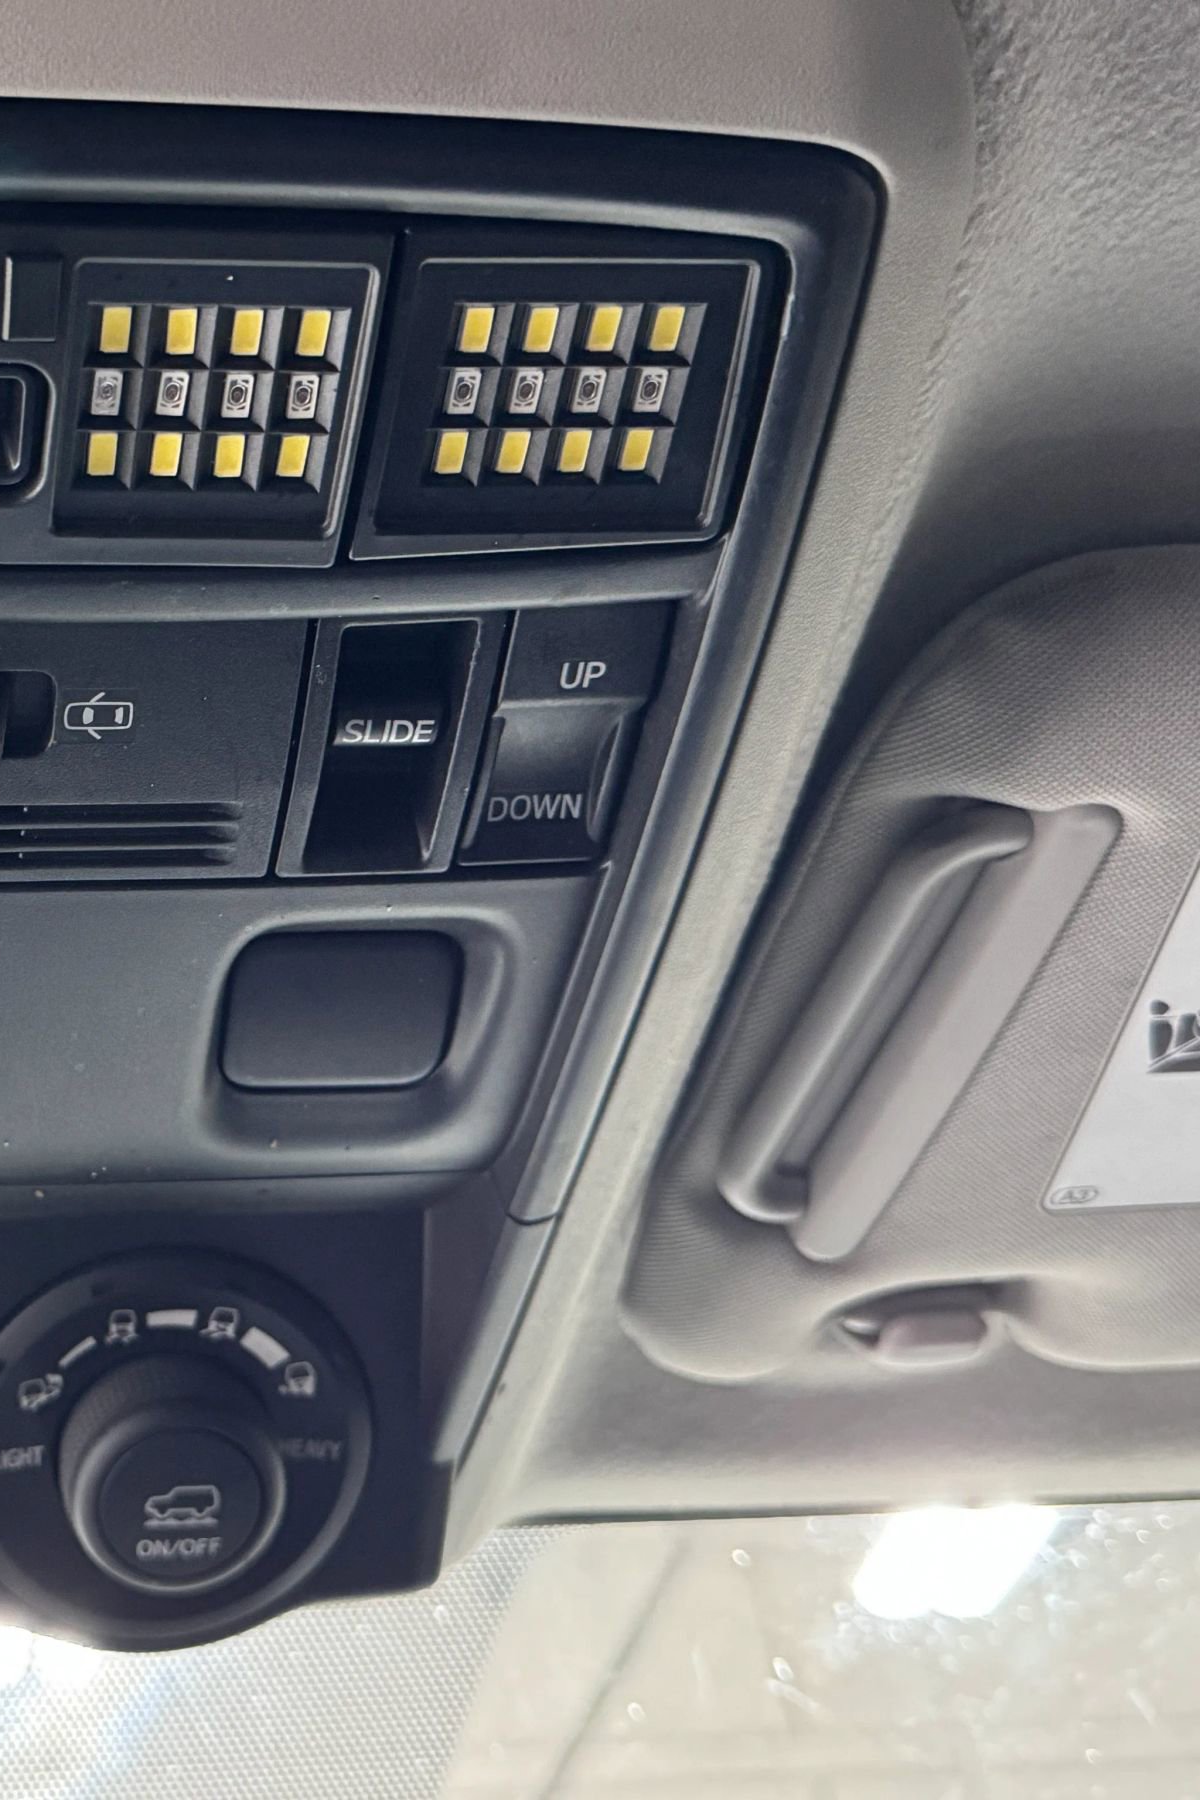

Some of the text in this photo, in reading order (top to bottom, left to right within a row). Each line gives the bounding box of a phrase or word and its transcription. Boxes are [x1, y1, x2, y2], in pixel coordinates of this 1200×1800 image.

[558, 661, 607, 690] UP
[341, 718, 435, 745] SLIDE
[487, 793, 583, 823] DOWN
[136, 1536, 222, 1560] ON/OFF
